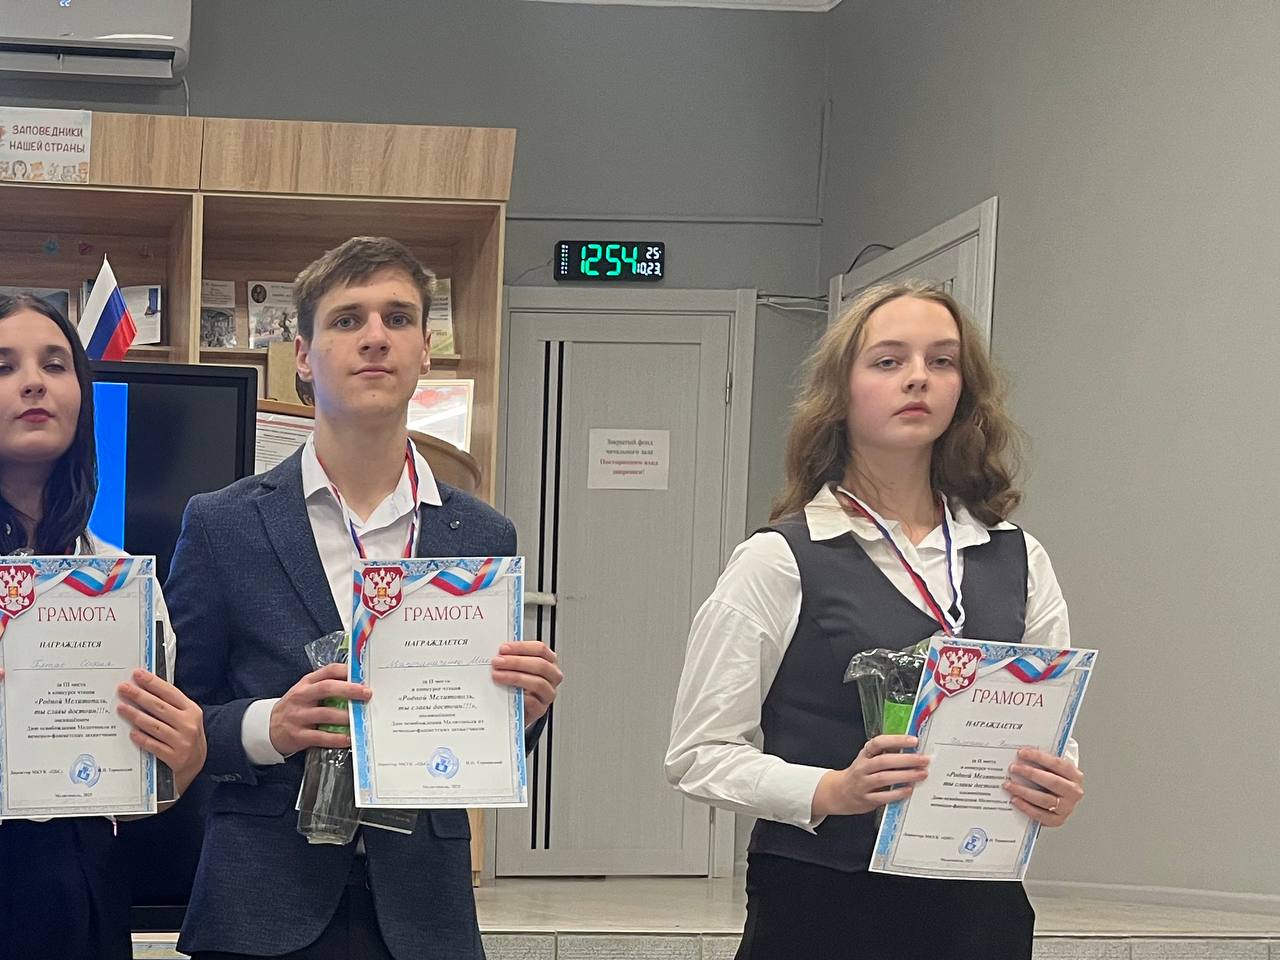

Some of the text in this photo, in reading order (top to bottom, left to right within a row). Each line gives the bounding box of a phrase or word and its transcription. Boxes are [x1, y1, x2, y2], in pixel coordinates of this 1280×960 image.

[12, 124, 83, 137] ЗАПОВЕДНИКИ
[9, 140, 85, 153] НАШЕЙ СТРАНЫ
[37, 606, 117, 622] ГРАМОТА
[404, 605, 484, 622] ГРАМОТА
[404, 638, 470, 647] НАГРАЖДАЕТСЯ
[971, 688, 1044, 707] ГРАМОТА
[965, 720, 1024, 730] НАГРАЖДАЕТСЯ
